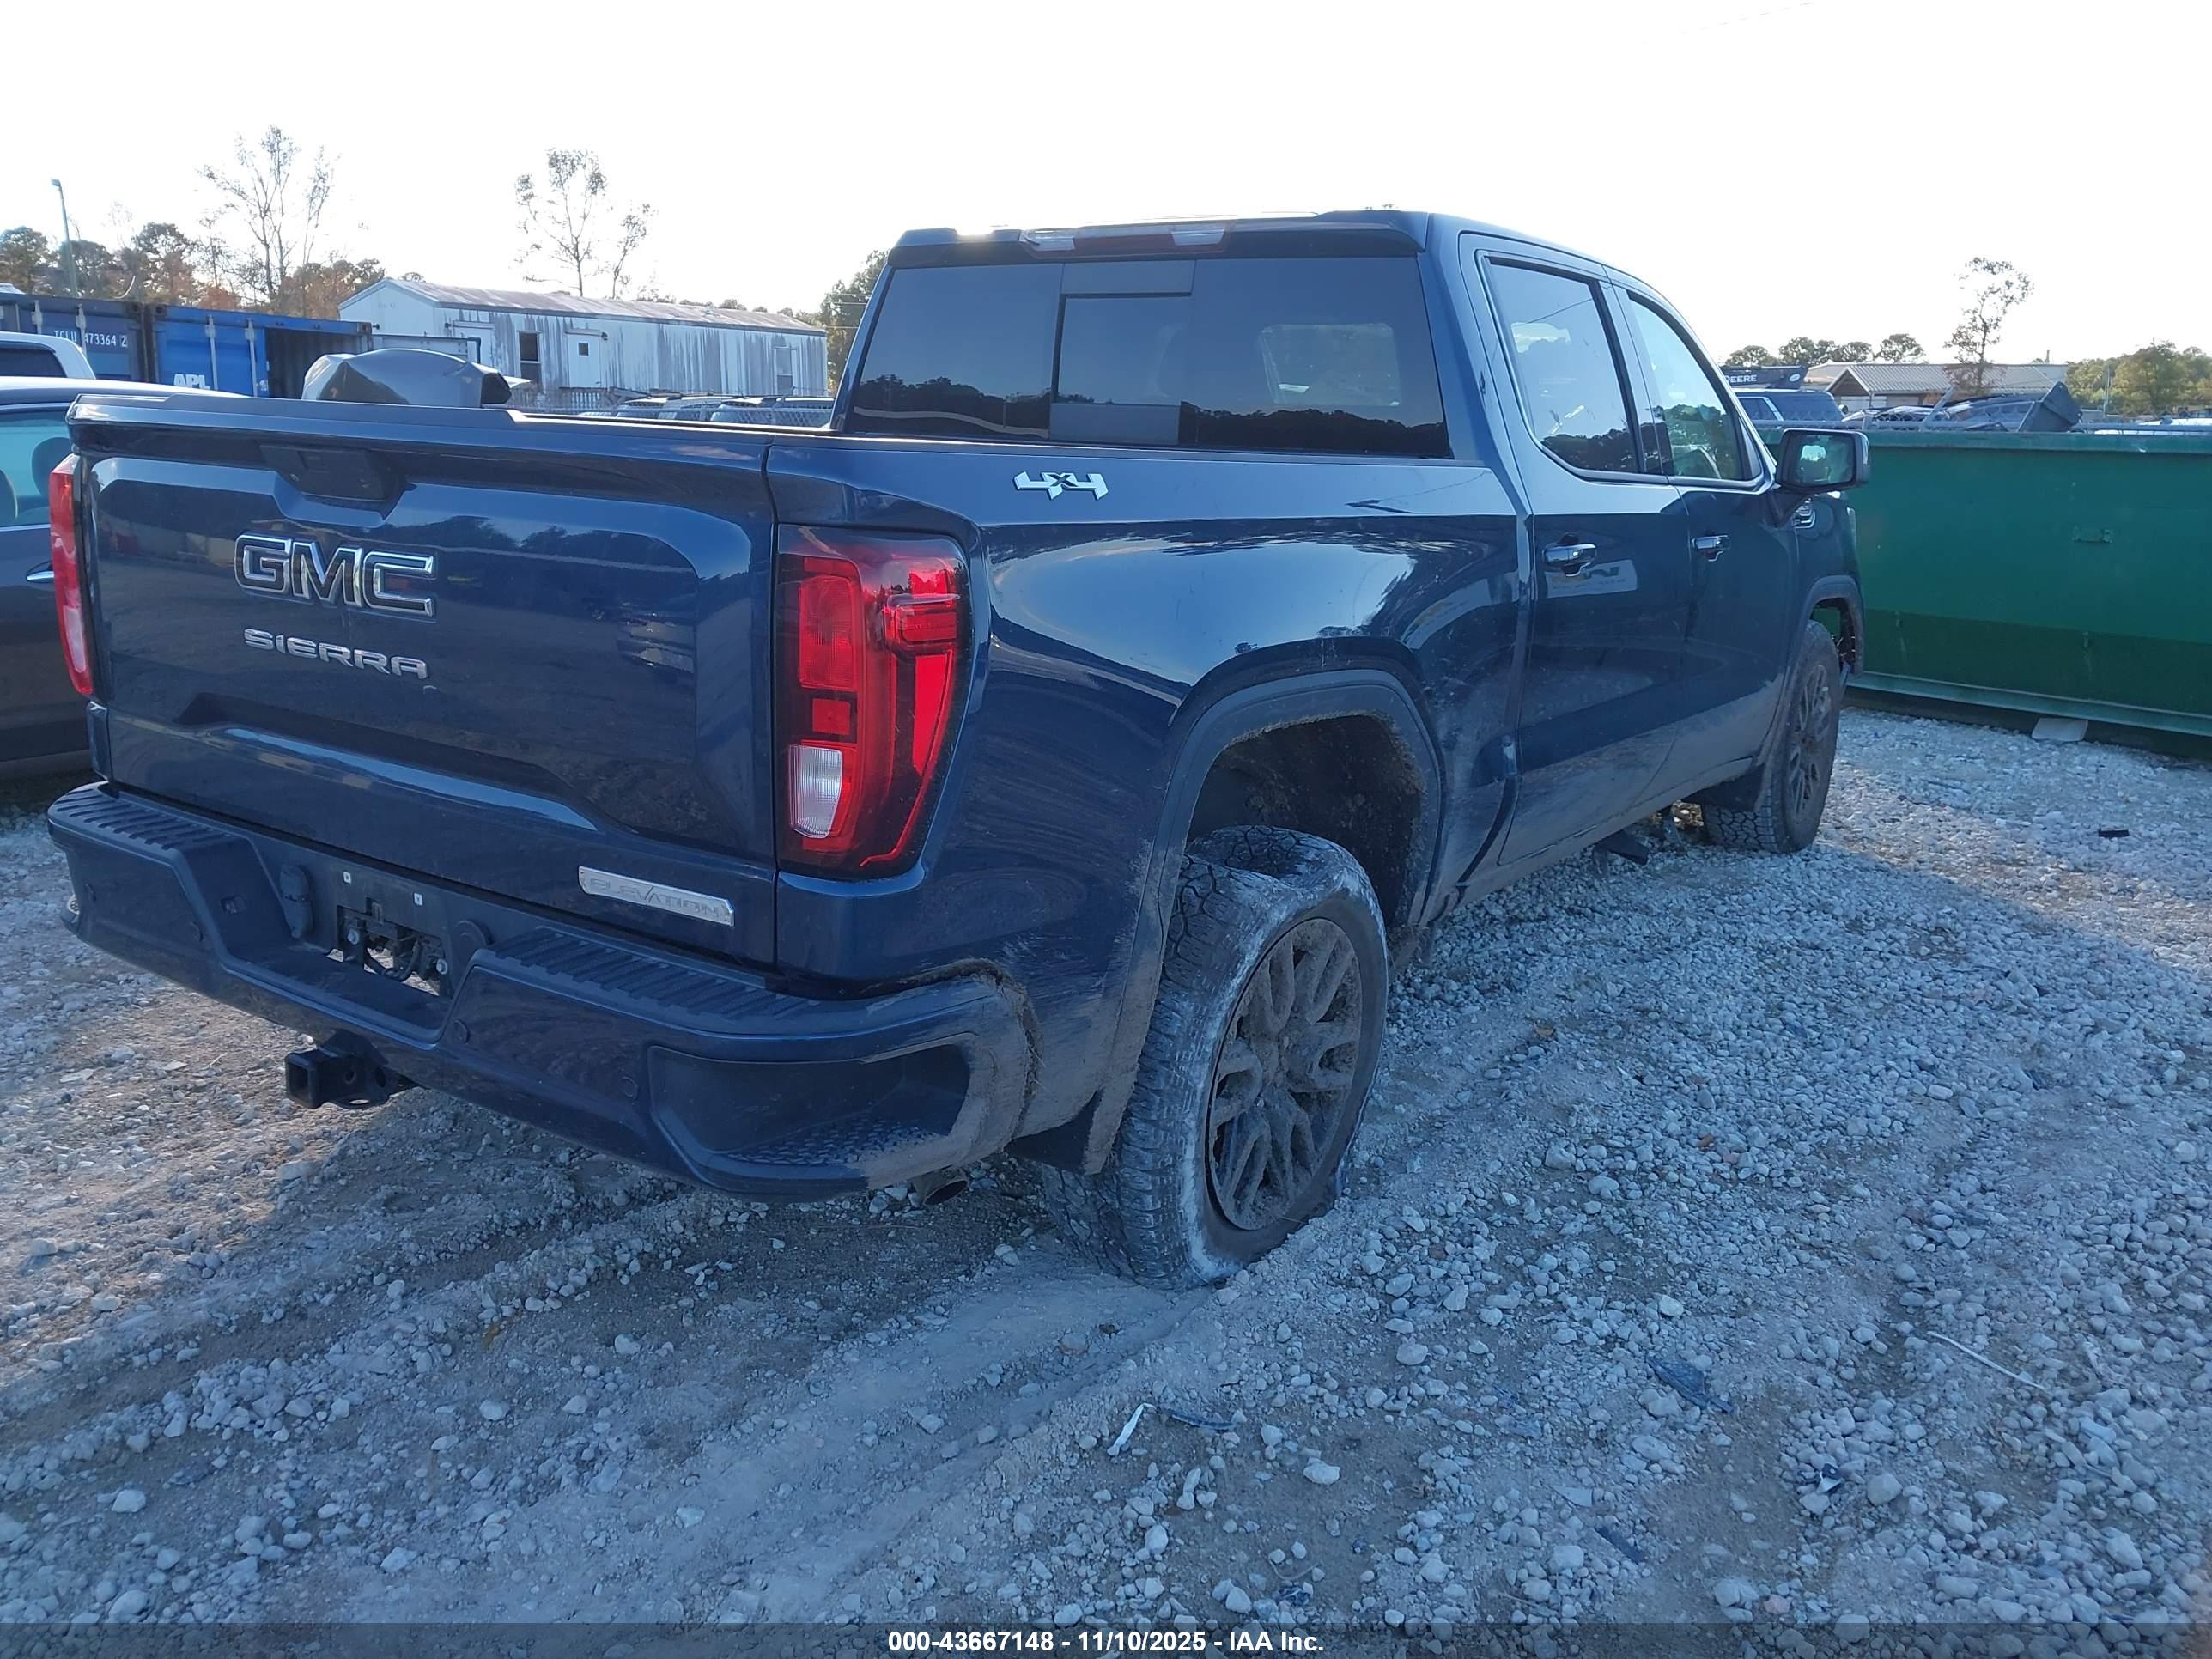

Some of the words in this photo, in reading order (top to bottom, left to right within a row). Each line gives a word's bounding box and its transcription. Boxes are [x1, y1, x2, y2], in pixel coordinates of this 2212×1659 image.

[173, 373, 210, 390] APL
[234, 533, 434, 617] GMC
[244, 629, 428, 679] SIERRA
